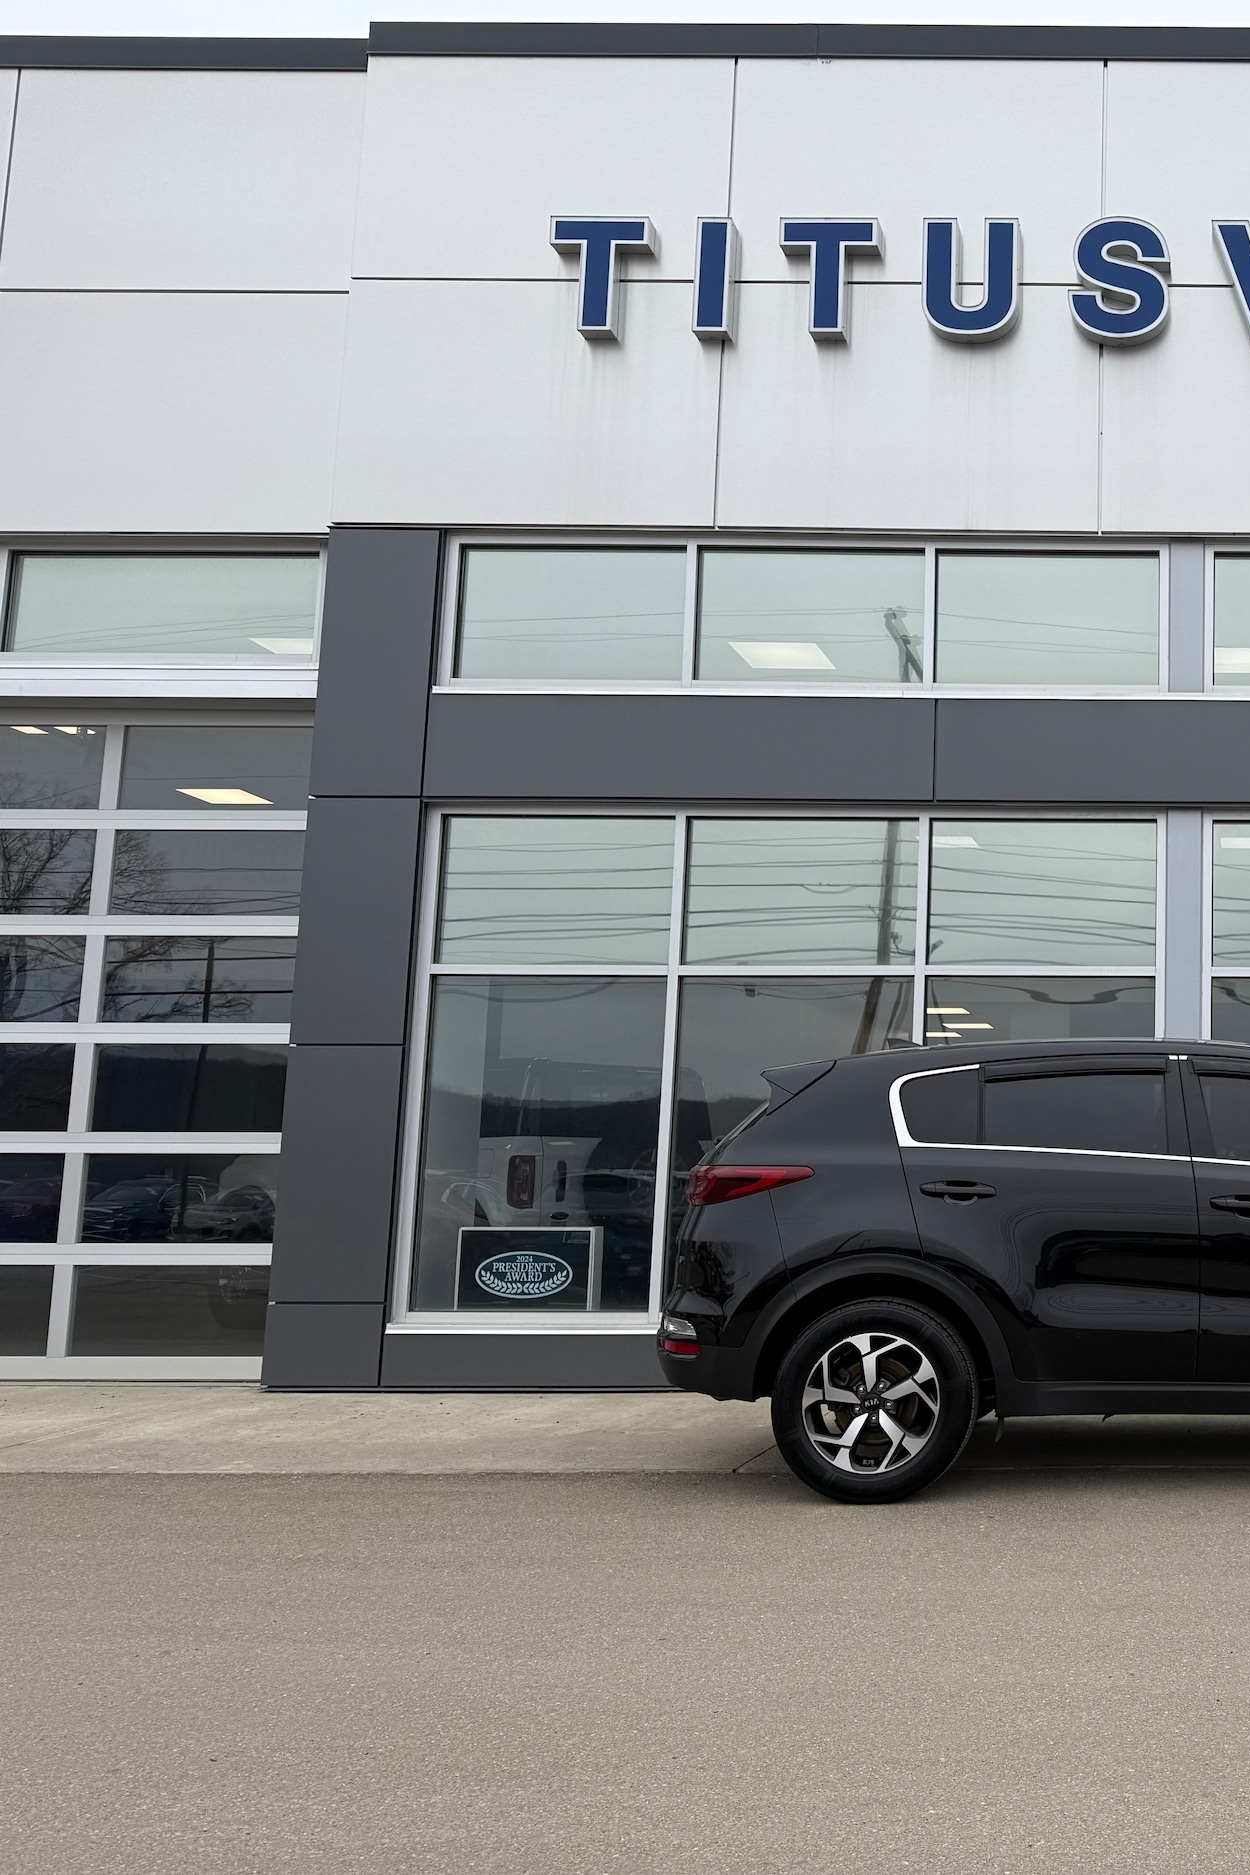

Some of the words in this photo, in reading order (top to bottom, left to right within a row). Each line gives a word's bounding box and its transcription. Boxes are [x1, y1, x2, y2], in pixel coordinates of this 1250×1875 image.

[492, 1262, 556, 1272] PRESIDENT'S
[504, 1272, 543, 1281] AWARD
[864, 1398, 880, 1407] KIA
